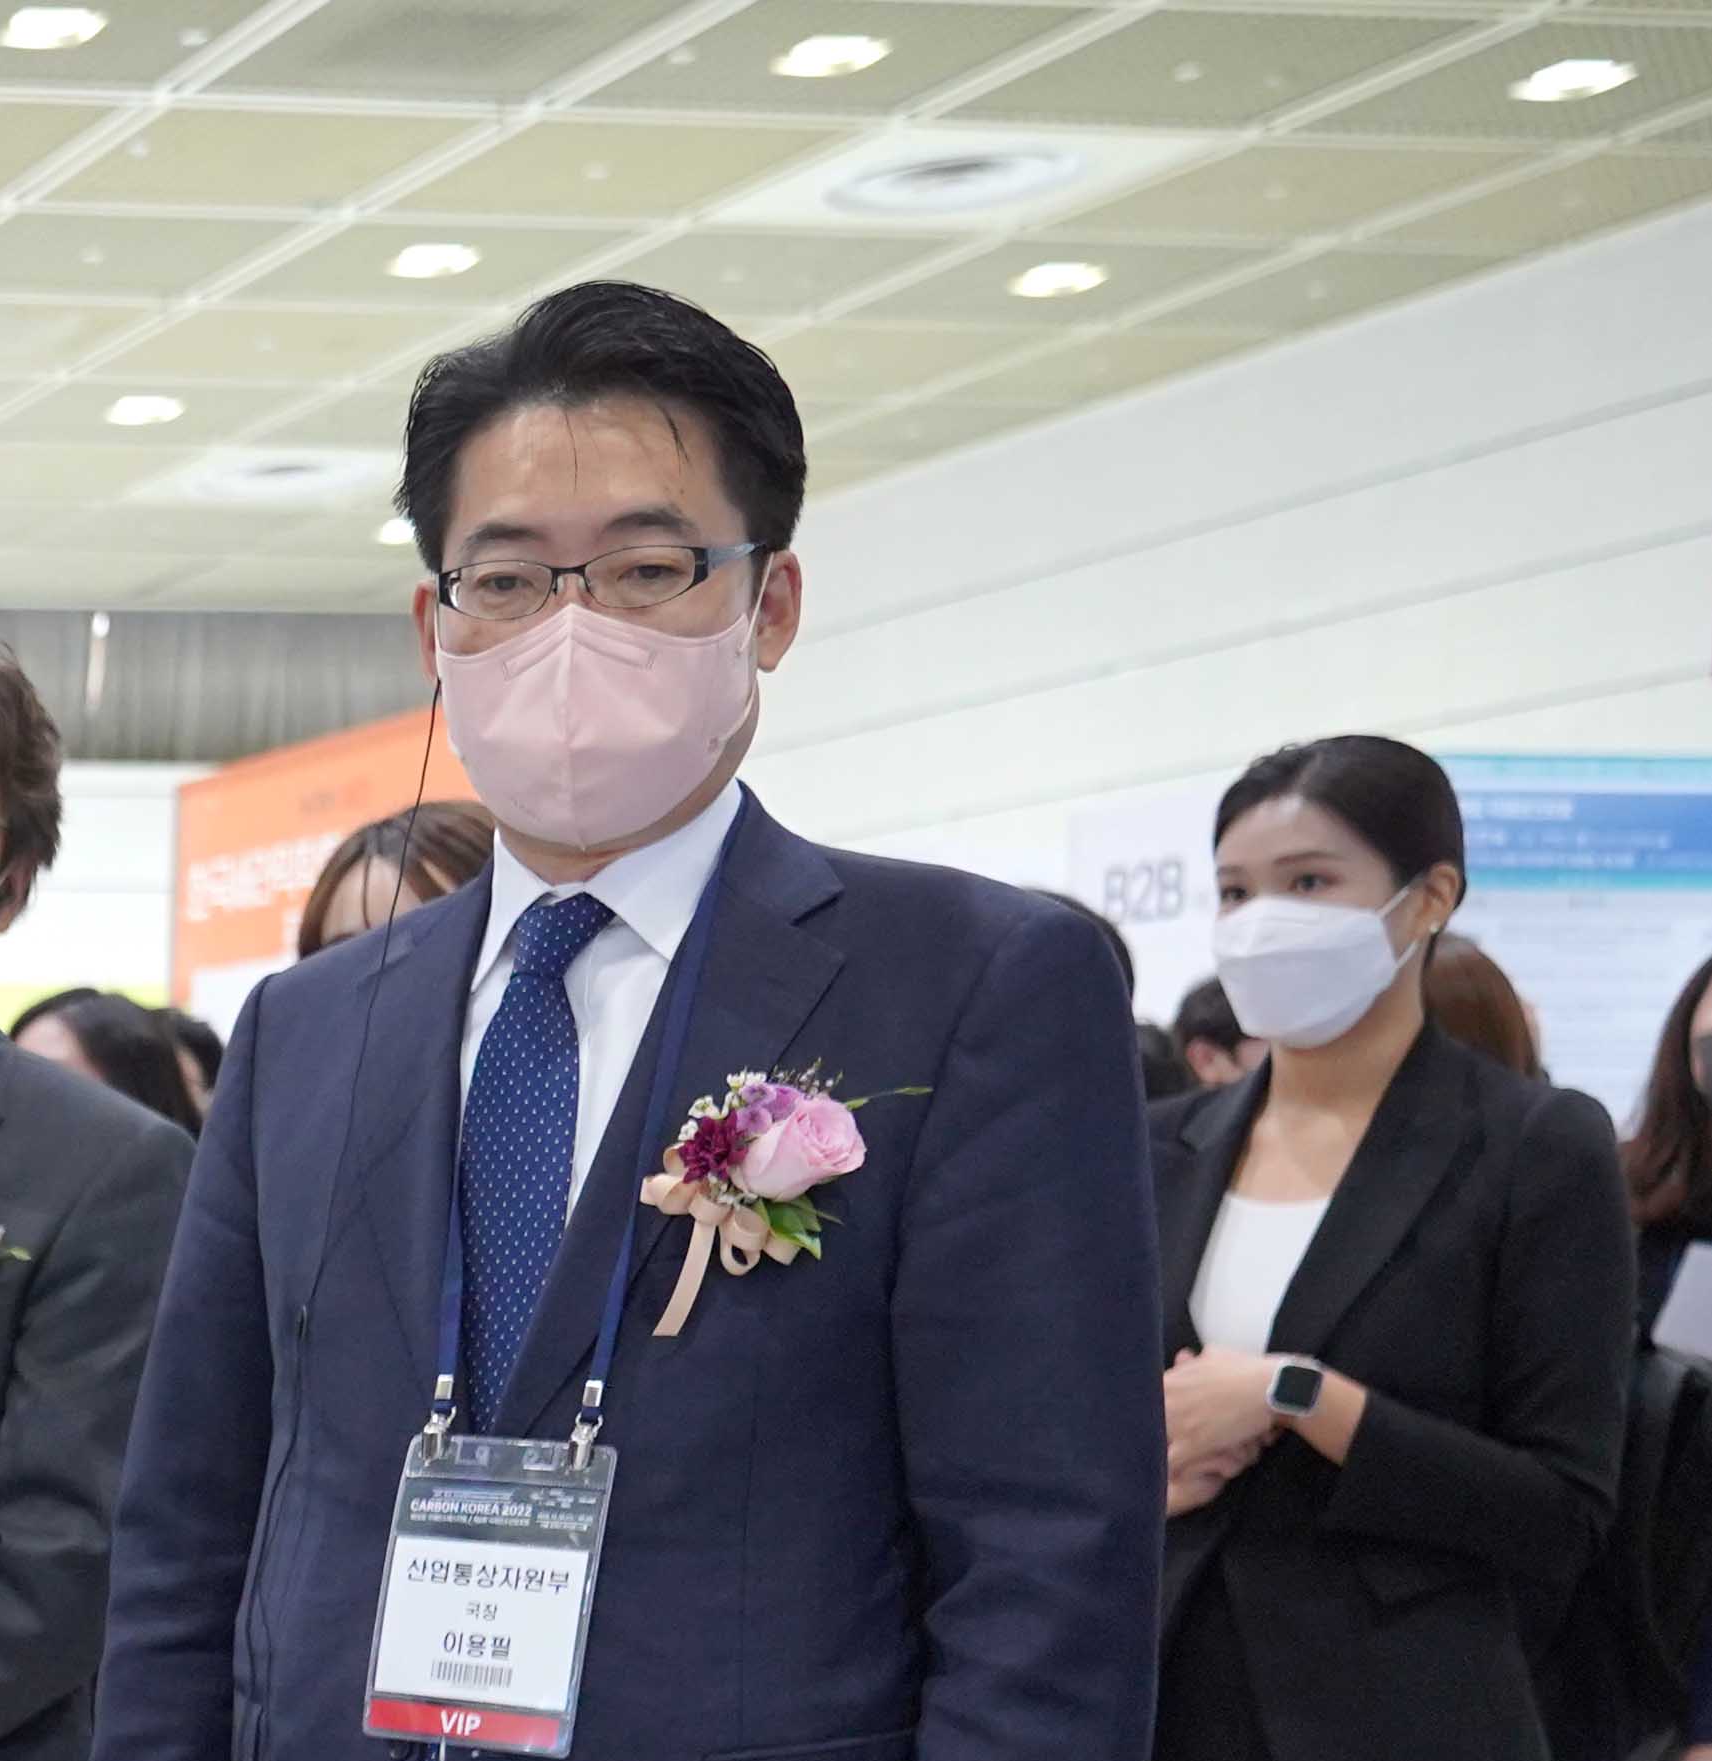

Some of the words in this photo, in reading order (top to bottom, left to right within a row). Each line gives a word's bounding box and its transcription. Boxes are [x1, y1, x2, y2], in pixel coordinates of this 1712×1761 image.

[1104, 858, 1184, 923] B2B
[409, 1498, 460, 1514] CARBON
[460, 1502, 501, 1516] KOREA
[501, 1502, 533, 1518] 2022
[407, 1558, 570, 1595] 산업통상자원부
[465, 1601, 499, 1622] 국장
[442, 1631, 512, 1659] 이용필
[440, 1709, 482, 1737] VIP
